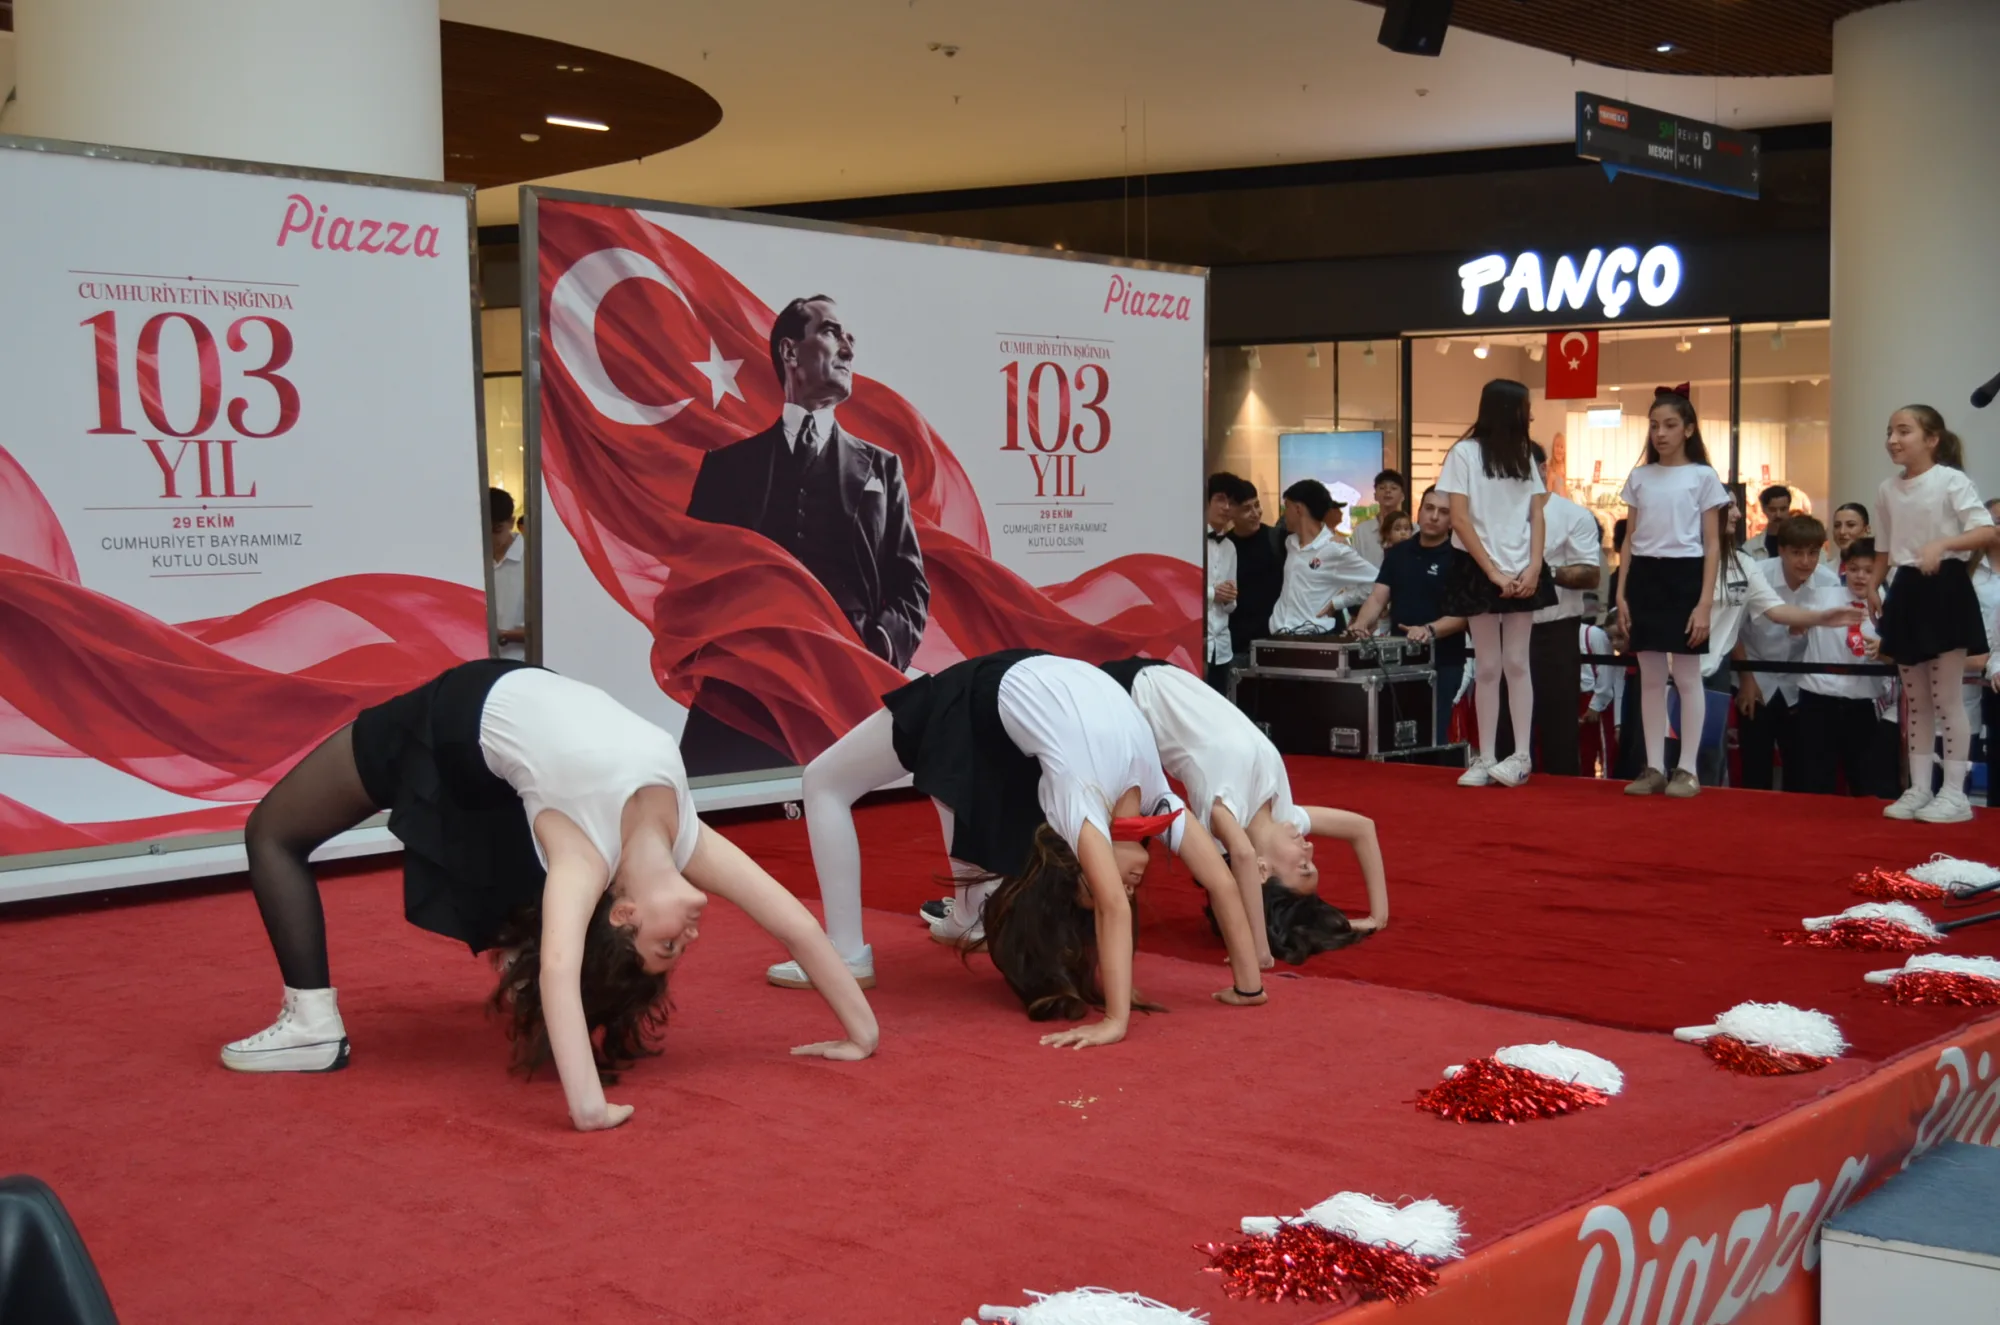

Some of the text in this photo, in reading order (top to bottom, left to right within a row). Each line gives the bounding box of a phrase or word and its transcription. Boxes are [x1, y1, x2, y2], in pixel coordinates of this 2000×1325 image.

[1677, 153, 1691, 167] WC
[277, 193, 440, 258] Piazza
[1458, 245, 1680, 318] PANÇO
[78, 281, 293, 311] CUMHURİYETİN IŞIĞINDA
[1104, 273, 1191, 321] Piazza
[1000, 339, 1073, 357] CUMHURİYETİN
[80, 310, 301, 438] 103
[999, 360, 1111, 453] 103
[142, 439, 257, 499] YIL
[1028, 453, 1086, 497] YIL
[172, 513, 236, 529] 29 EKİM
[1040, 507, 1073, 519] 29 EKİM
[1002, 522, 1108, 535] CUMHURİYET BAYRAMIMIZ
[101, 533, 303, 551] CUMHURİYET BAYRAMIMIZ
[1028, 535, 1084, 547] KUTLU OLSUN
[152, 552, 259, 568] KUTLU OLSUN
